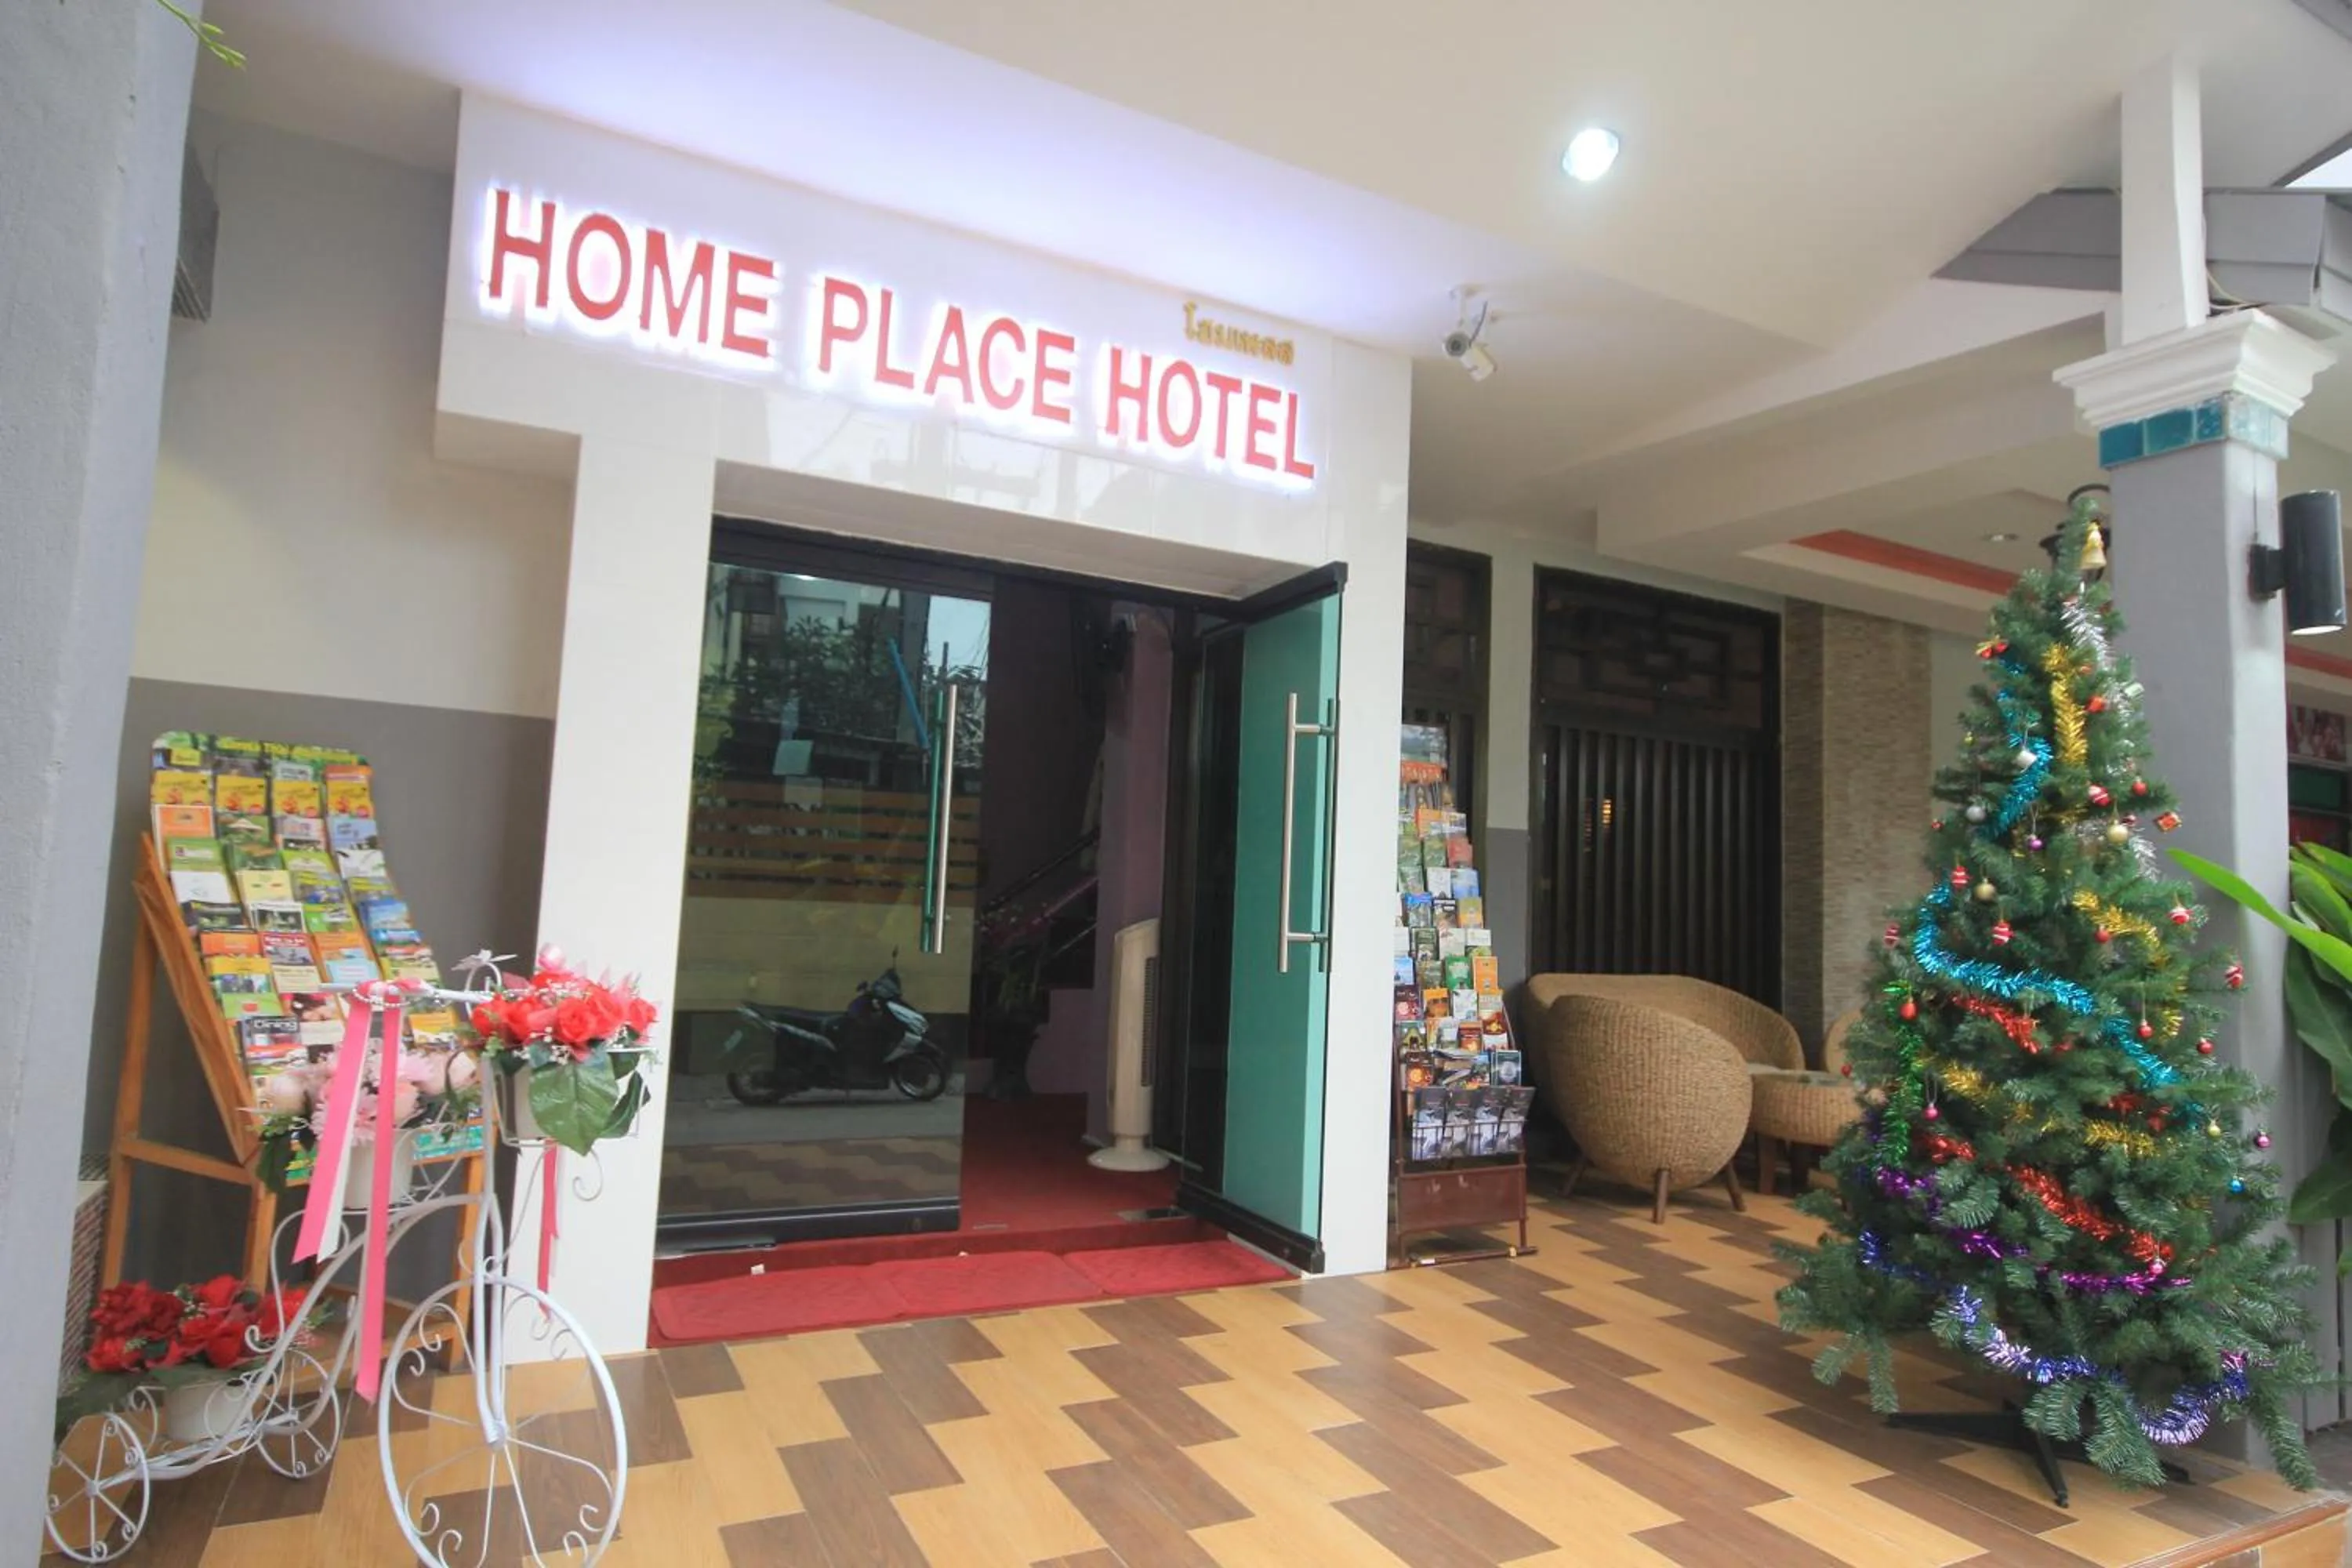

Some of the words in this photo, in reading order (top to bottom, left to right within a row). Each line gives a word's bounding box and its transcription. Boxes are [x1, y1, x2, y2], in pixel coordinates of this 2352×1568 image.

[489, 189, 775, 358] HOME
[820, 277, 1076, 423] PLACE
[1105, 346, 1315, 479] HOTEL
[253, 1019, 297, 1031] Dining
